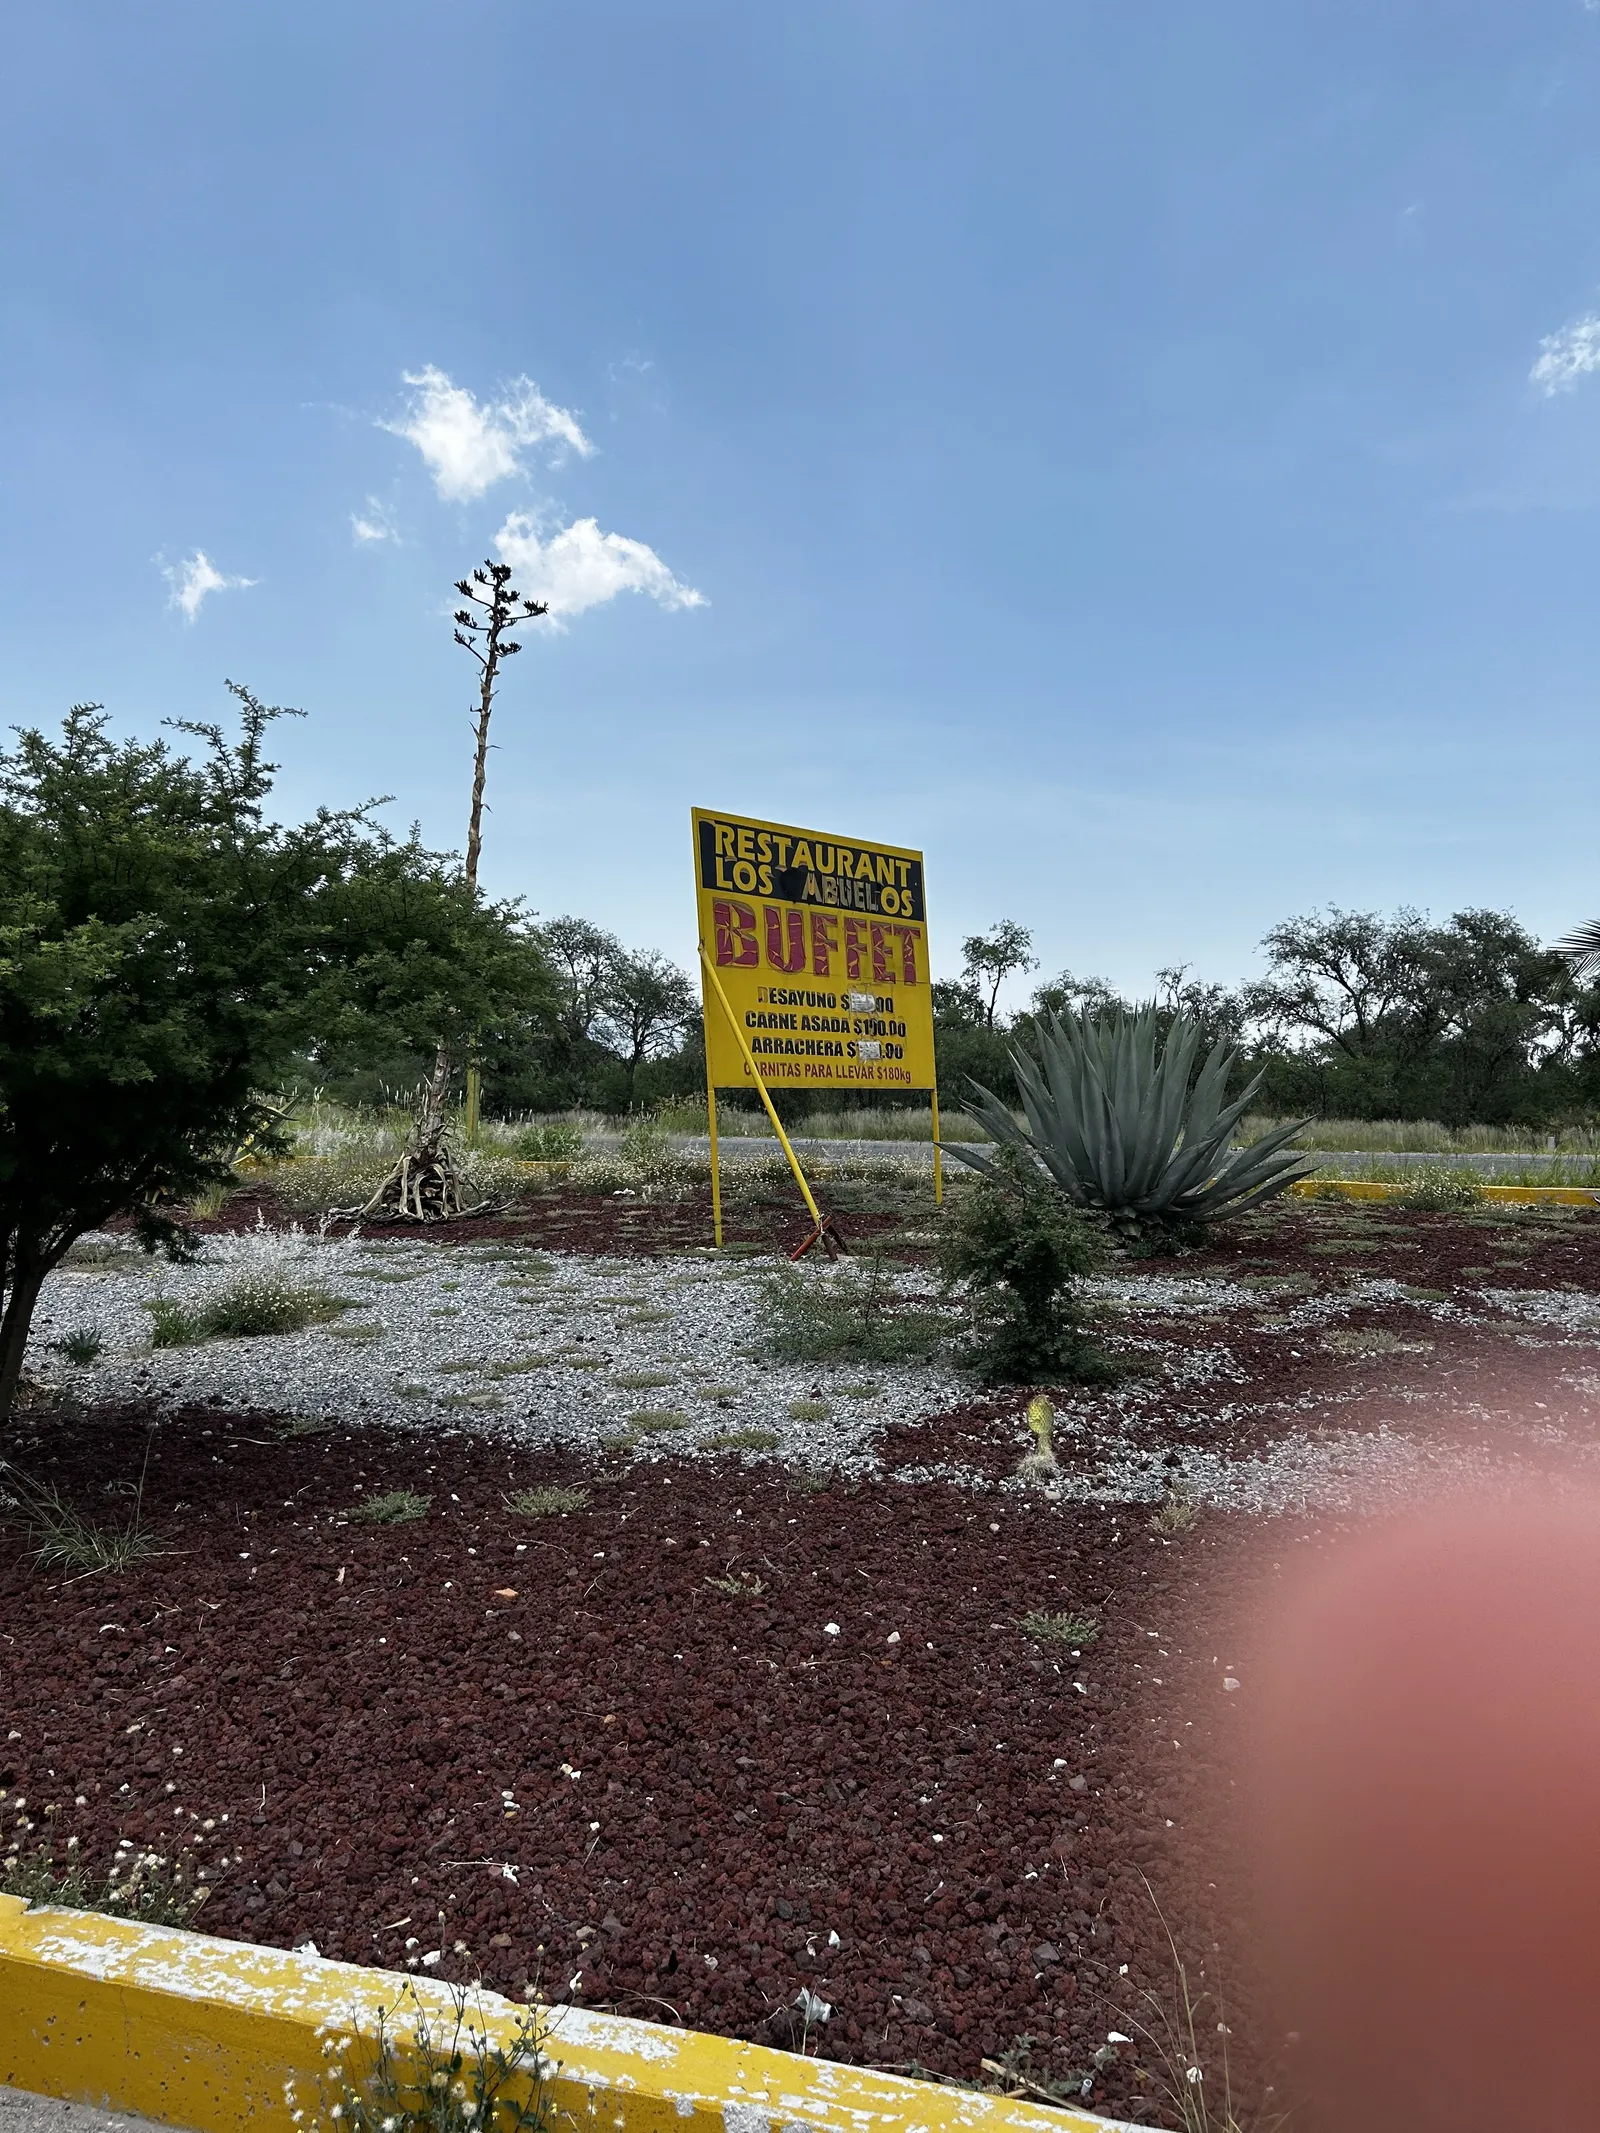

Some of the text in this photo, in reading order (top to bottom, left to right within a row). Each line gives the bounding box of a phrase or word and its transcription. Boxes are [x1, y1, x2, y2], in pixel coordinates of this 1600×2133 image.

[714, 823, 912, 888] RESTAURANT
[715, 856, 914, 918] LOS ABUELOS
[712, 897, 922, 987] BUFFET
[745, 1010, 798, 1031] CARNE
[801, 1013, 850, 1034] ASADA
[751, 1036, 844, 1057] ARRACHERA
[804, 1063, 833, 1078] PARA
[835, 1064, 874, 1080] LLEVAR
